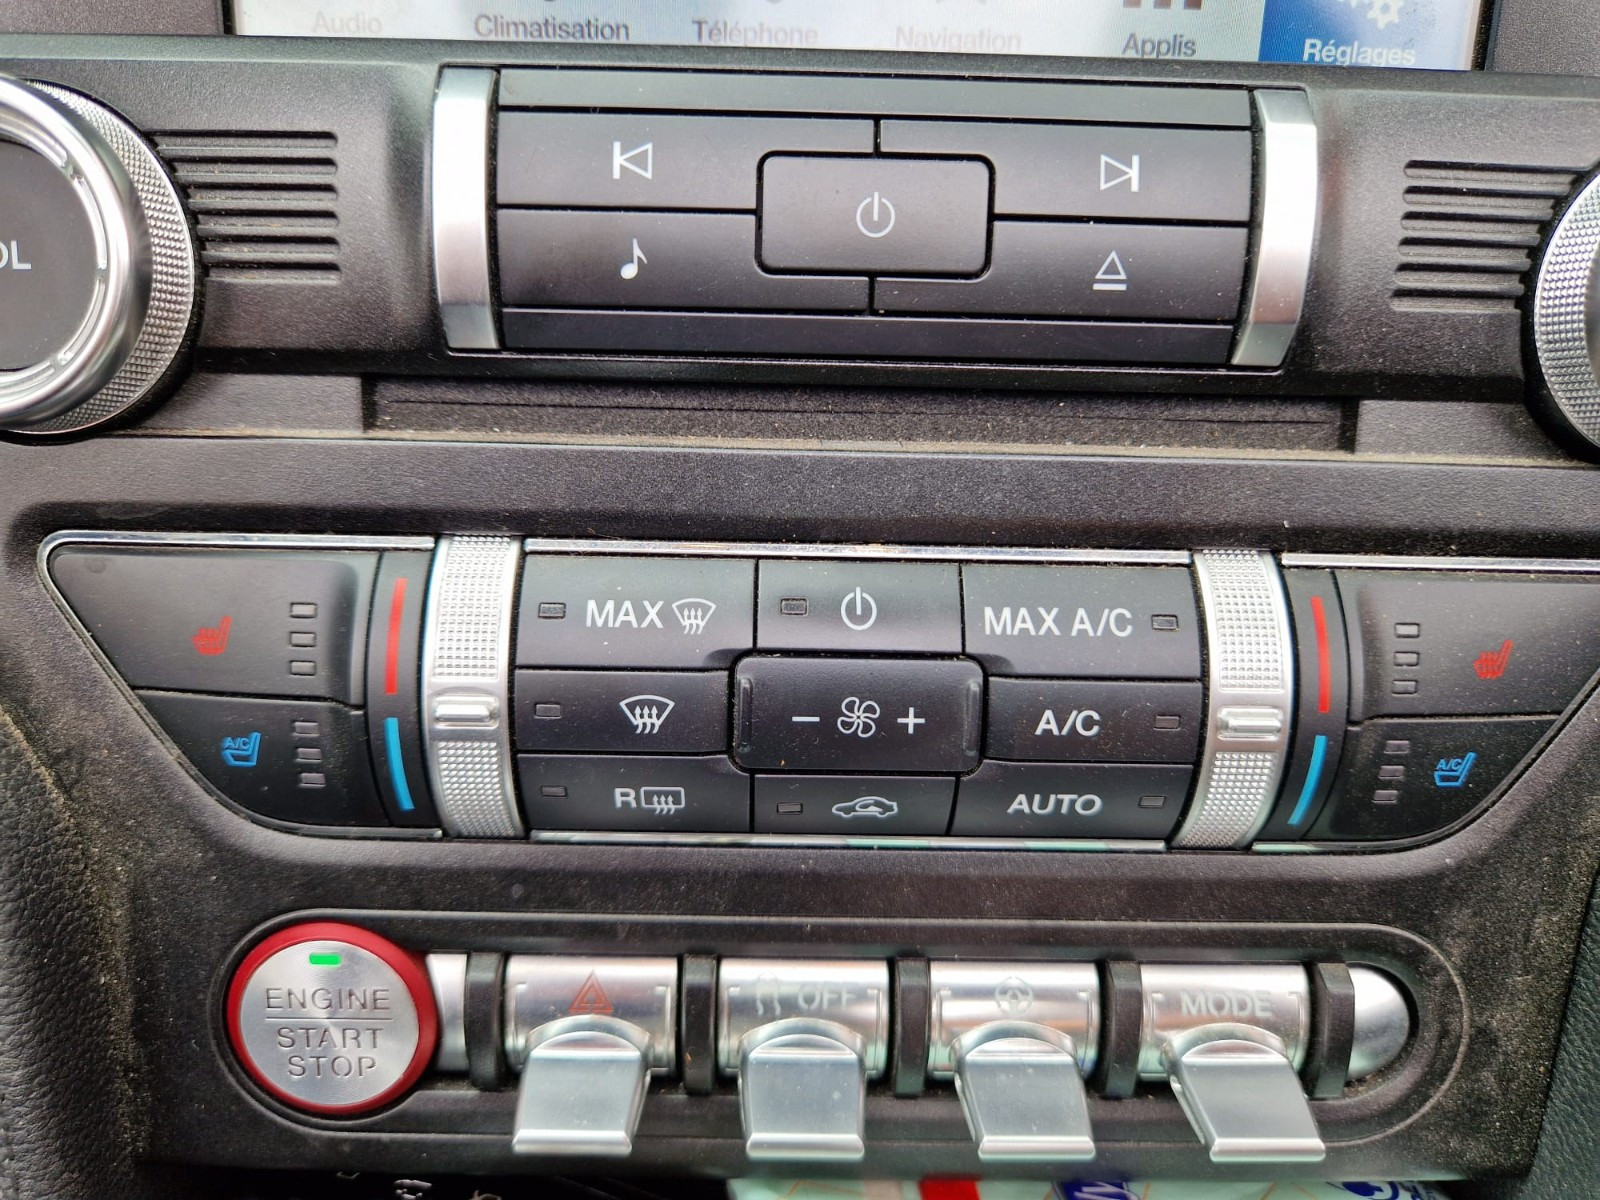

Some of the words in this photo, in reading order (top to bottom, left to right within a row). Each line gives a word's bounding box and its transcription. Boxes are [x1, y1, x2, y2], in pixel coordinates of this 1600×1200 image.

[311, 10, 383, 34] Audio
[474, 13, 630, 42] Climatisation
[691, 18, 819, 48] Téléphone
[895, 25, 1022, 53] Navigation
[1121, 32, 1197, 59] Applis
[1302, 38, 1417, 66] Réglages
[585, 599, 664, 629] MAX
[983, 606, 1061, 636] MAX
[1071, 607, 1133, 638] A/C
[1034, 709, 1101, 737] A/C
[223, 736, 250, 750] A/C
[1435, 758, 1462, 771] A/C
[613, 787, 638, 808] R
[1006, 793, 1103, 816] AUTO
[265, 987, 391, 1011] ENGINE
[797, 980, 857, 1011] OFF
[1179, 989, 1273, 1018] MODE
[276, 1026, 384, 1050] START
[287, 1055, 377, 1078] STOP
